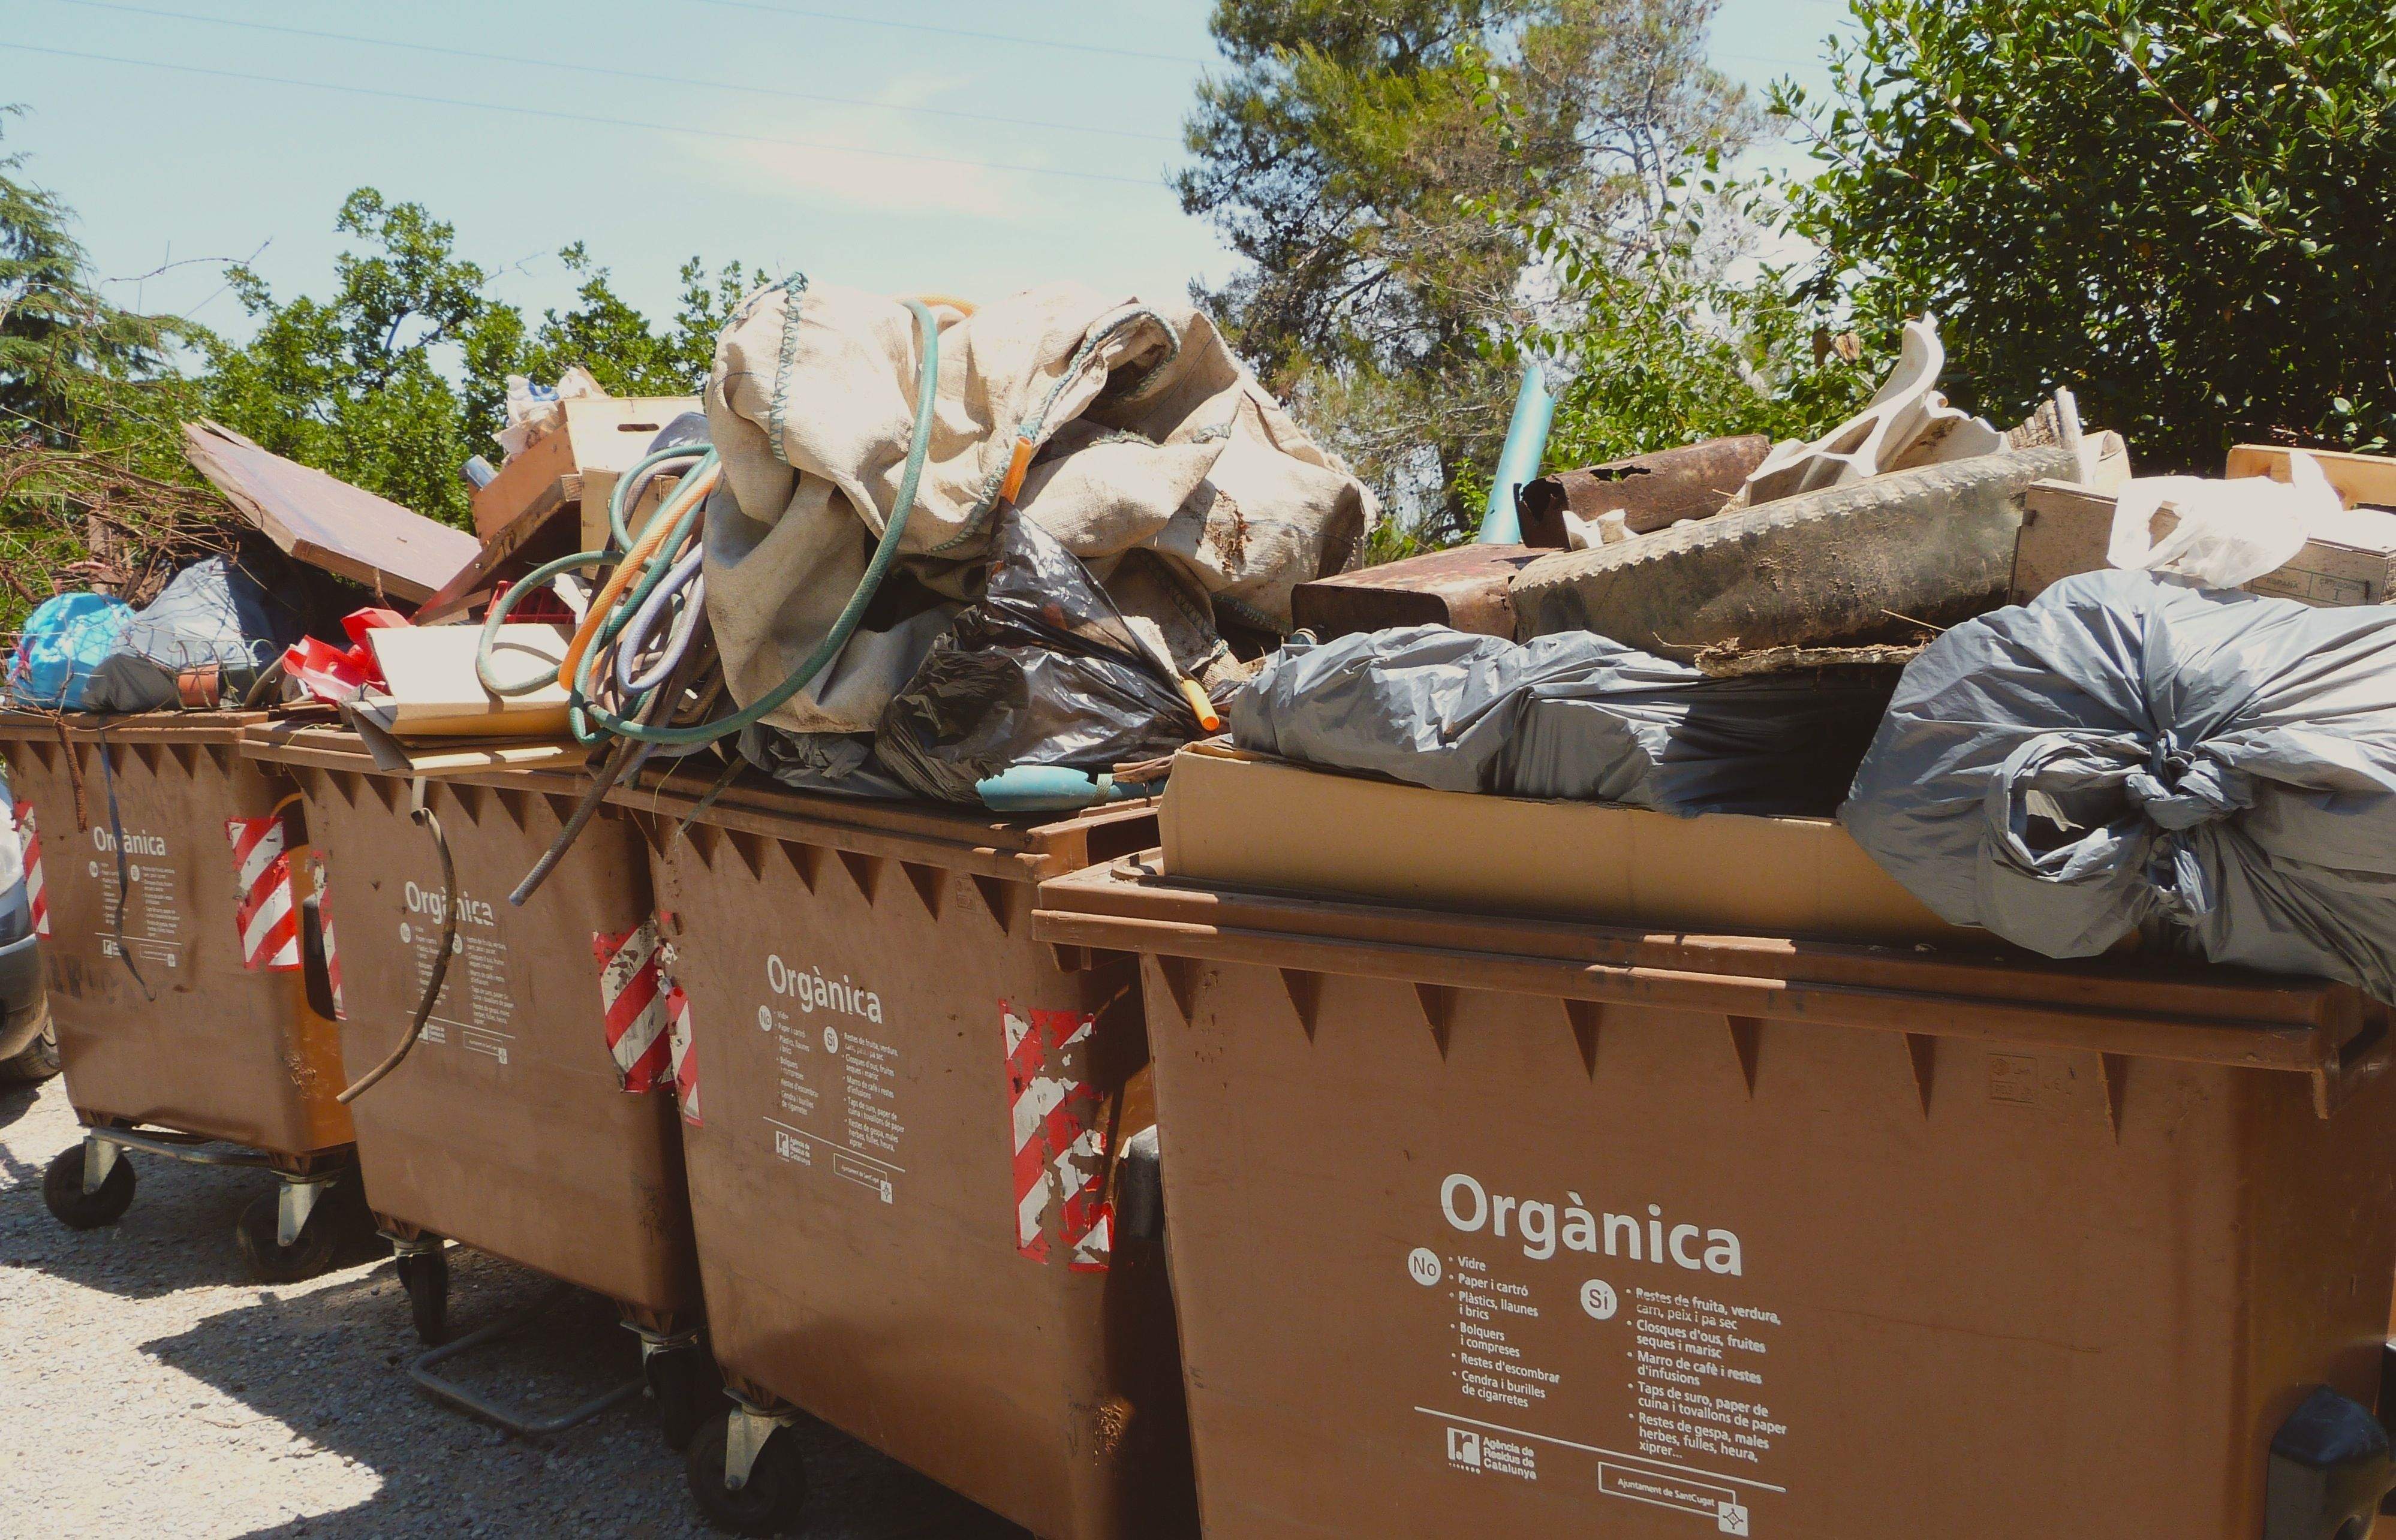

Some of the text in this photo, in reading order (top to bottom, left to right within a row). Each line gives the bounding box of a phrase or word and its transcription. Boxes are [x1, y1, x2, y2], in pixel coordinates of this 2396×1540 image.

[94, 826, 165, 856] Orànica
[767, 954, 882, 1024] Orgànica
[1441, 1173, 1742, 1276] Orgànica
[1413, 1256, 1437, 1277] No
[1458, 1255, 1486, 1271] Vidre
[1458, 1273, 1528, 1297] Paper i cartró
[1459, 1291, 1539, 1317] Plàstics, llaunes
[1589, 1289, 1608, 1310] Sí
[1636, 1288, 1781, 1325] Restes de fruita, verdura,
[1459, 1304, 1490, 1320] i brics
[1636, 1304, 1738, 1330] carn, peix i pa sec
[1460, 1321, 1506, 1341] Bolquers
[1636, 1319, 1766, 1354] Closques d'ous, fruites
[1461, 1335, 1521, 1358] i compreses
[1636, 1334, 1722, 1359] seques i marisc
[1461, 1352, 1493, 1369] Restes
[1638, 1350, 1763, 1385] Marro de cafè i restes
[1462, 1370, 1546, 1398] Cendra i burilles
[1638, 1364, 1700, 1386] d'infusions
[1462, 1384, 1528, 1408] de cigarretes
[1638, 1381, 1769, 1418] Taps de suro, paper de
[1638, 1396, 1787, 1435] cuina i tovallons de paper
[1639, 1412, 1769, 1449] Restes de gespa, males
[1483, 1437, 1534, 1457] Agència de
[1639, 1426, 1758, 1463] herbes, fulles, heura,
[1639, 1440, 1682, 1458] xiprer...
[1484, 1447, 1534, 1467] Residus de
[1484, 1458, 1537, 1480] Catalunya
[1618, 1478, 1661, 1495] Ajuntament
[1663, 1487, 1673, 1497] de
